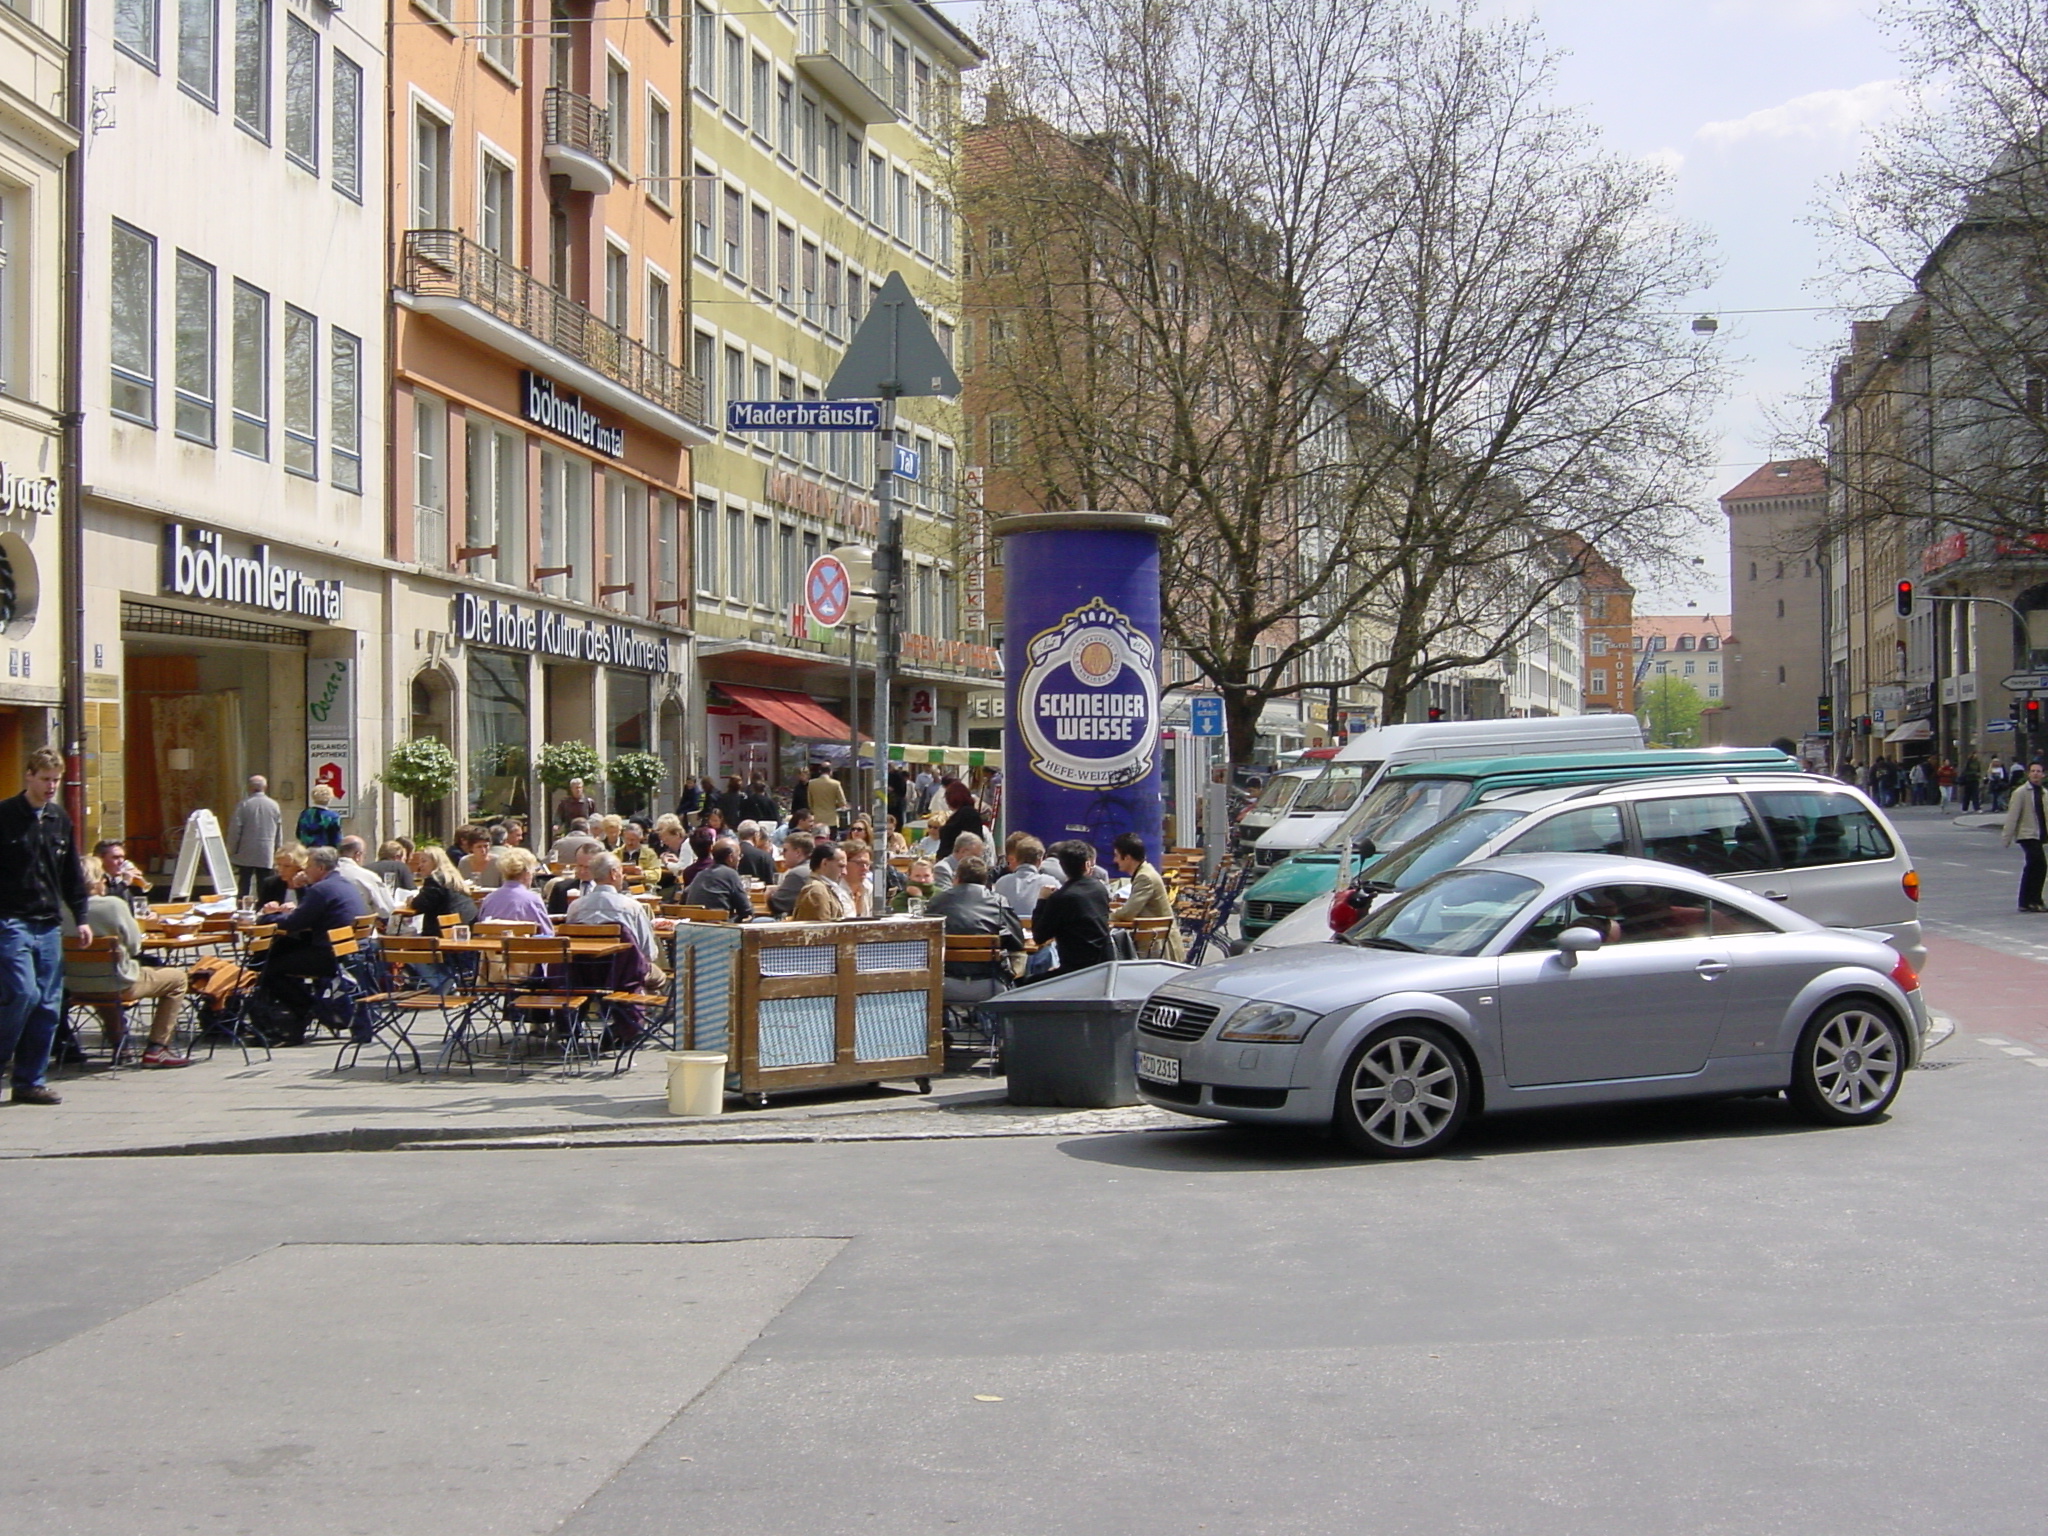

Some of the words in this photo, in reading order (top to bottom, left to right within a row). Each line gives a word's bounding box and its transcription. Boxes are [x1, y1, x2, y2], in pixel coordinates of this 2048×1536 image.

[529, 371, 597, 445] böhmler
[597, 418, 611, 453] im
[611, 427, 624, 459] tal
[734, 403, 875, 426] Maderbräustr.
[898, 450, 914, 475] Tal
[0, 461, 60, 517] haus
[966, 470, 980, 628] APOTHEKE
[174, 524, 298, 611] böhmler
[298, 571, 322, 617] im
[323, 580, 345, 621] tal
[463, 593, 492, 643] Die
[496, 600, 537, 650] hohe
[541, 610, 582, 659] Kultur
[586, 621, 611, 663] des
[1040, 693, 1145, 718] SCHNEIDER
[1056, 718, 1132, 741] WEISSE
[1156, 1059, 1178, 1080] 2315
